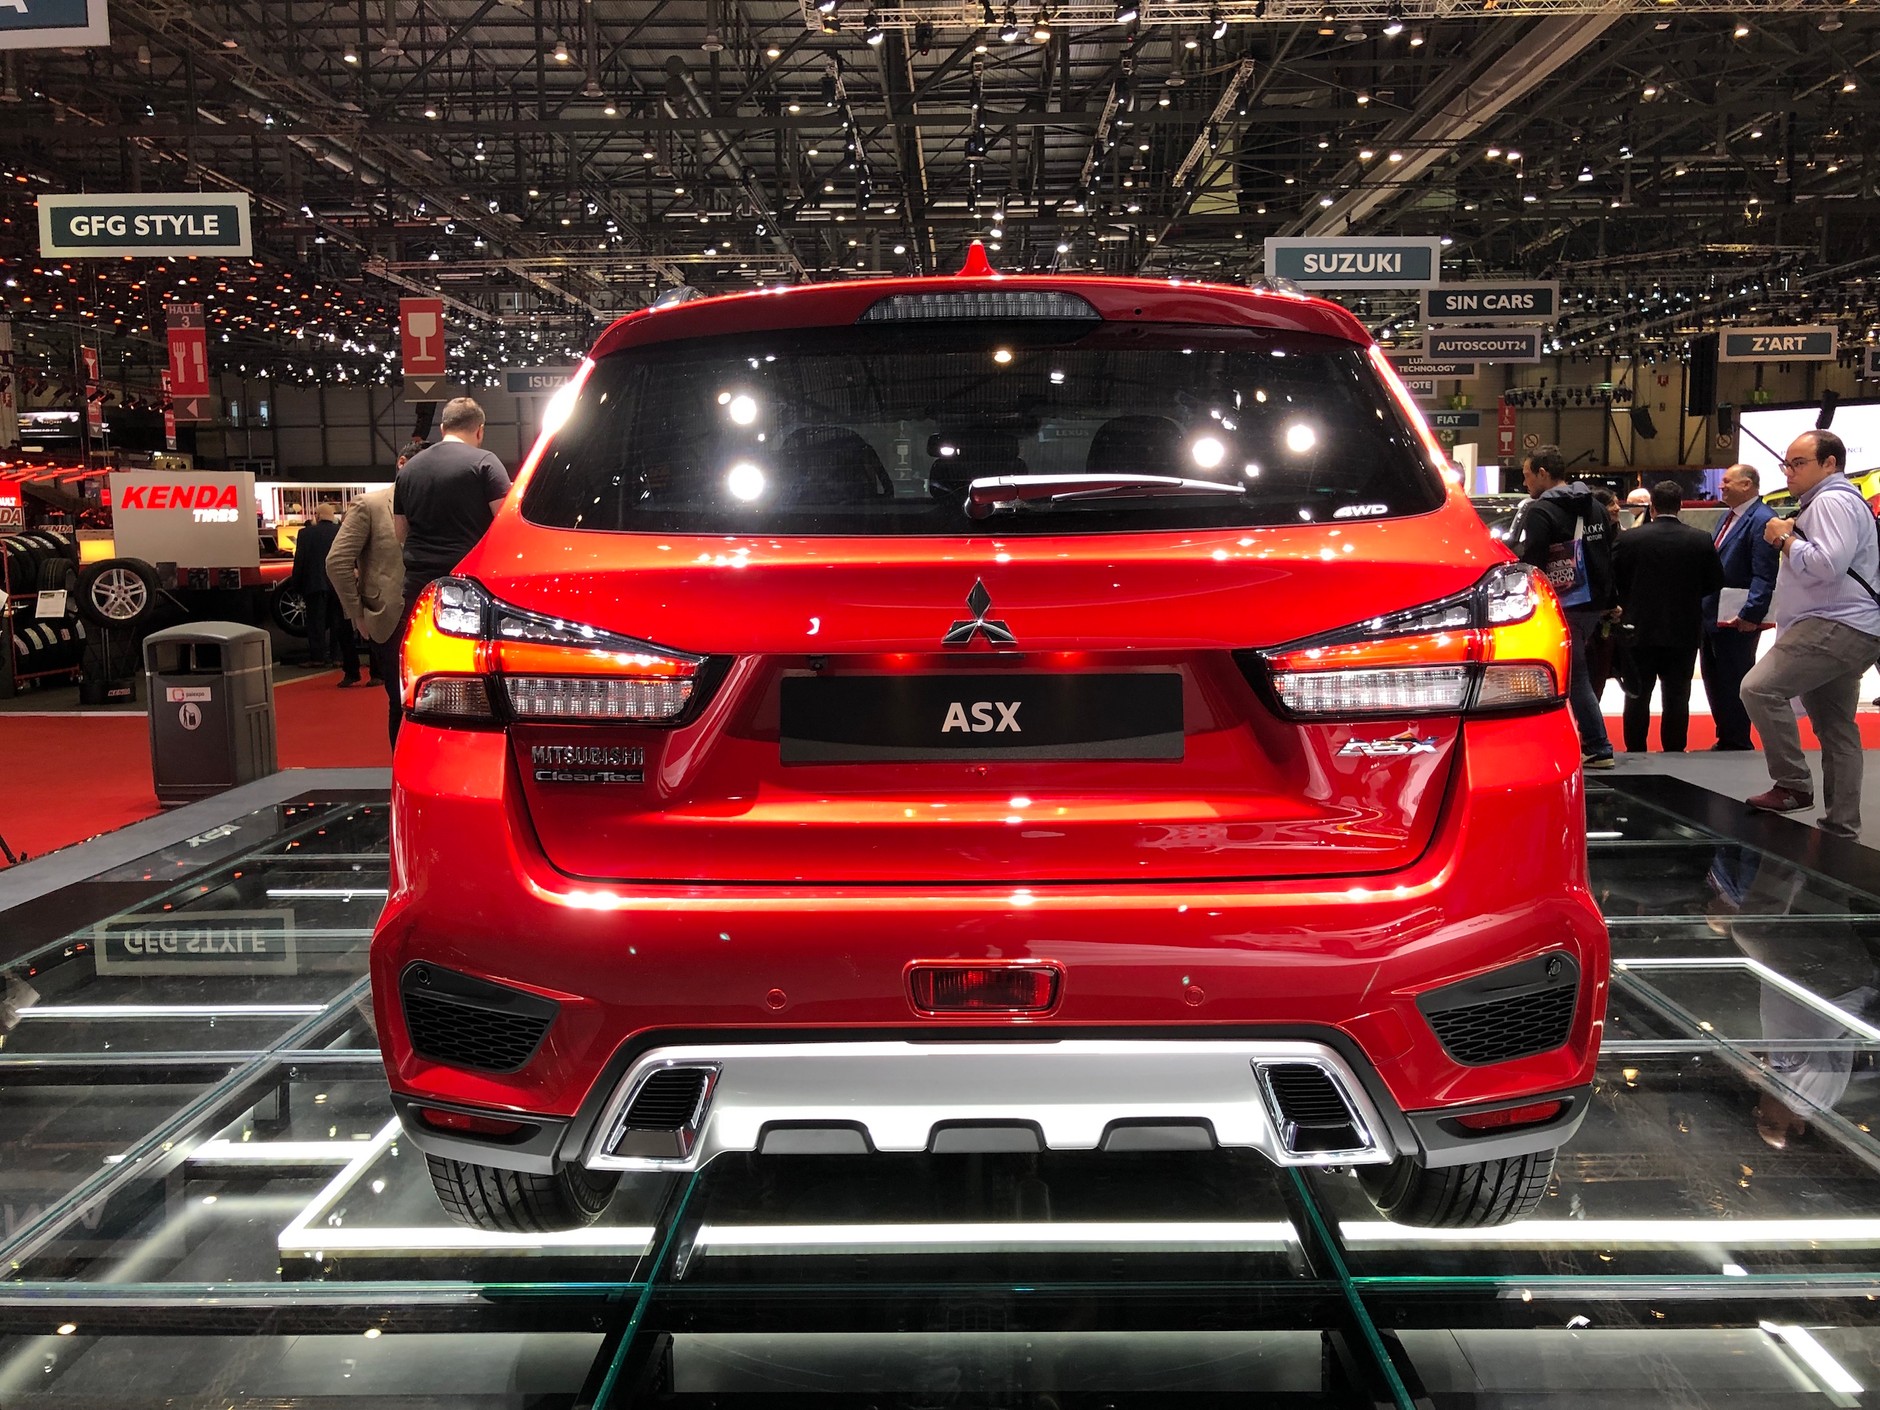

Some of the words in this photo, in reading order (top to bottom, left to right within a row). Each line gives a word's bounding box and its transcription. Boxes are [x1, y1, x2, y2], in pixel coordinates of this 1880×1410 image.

[69, 215, 127, 237] GFG
[134, 214, 219, 236] STYLE
[1303, 253, 1401, 273] SUZUKI
[1445, 295, 1478, 310] SIN
[1483, 294, 1534, 309] CARS
[169, 306, 201, 315] HALLE
[181, 315, 191, 328] 3
[1437, 340, 1526, 351] AUTOSCOUT24
[1752, 336, 1807, 351] Z'ART
[1399, 365, 1456, 373] TECHNOLOGY
[1437, 416, 1460, 424] FIAT
[121, 485, 238, 509] KENDA
[192, 508, 239, 523] TIRES
[1333, 504, 1388, 518] 4WD
[941, 701, 1022, 733] ASX
[1336, 737, 1440, 757] ASX
[531, 746, 645, 765] MITSUBISHI
[535, 771, 642, 782] ClearTec
